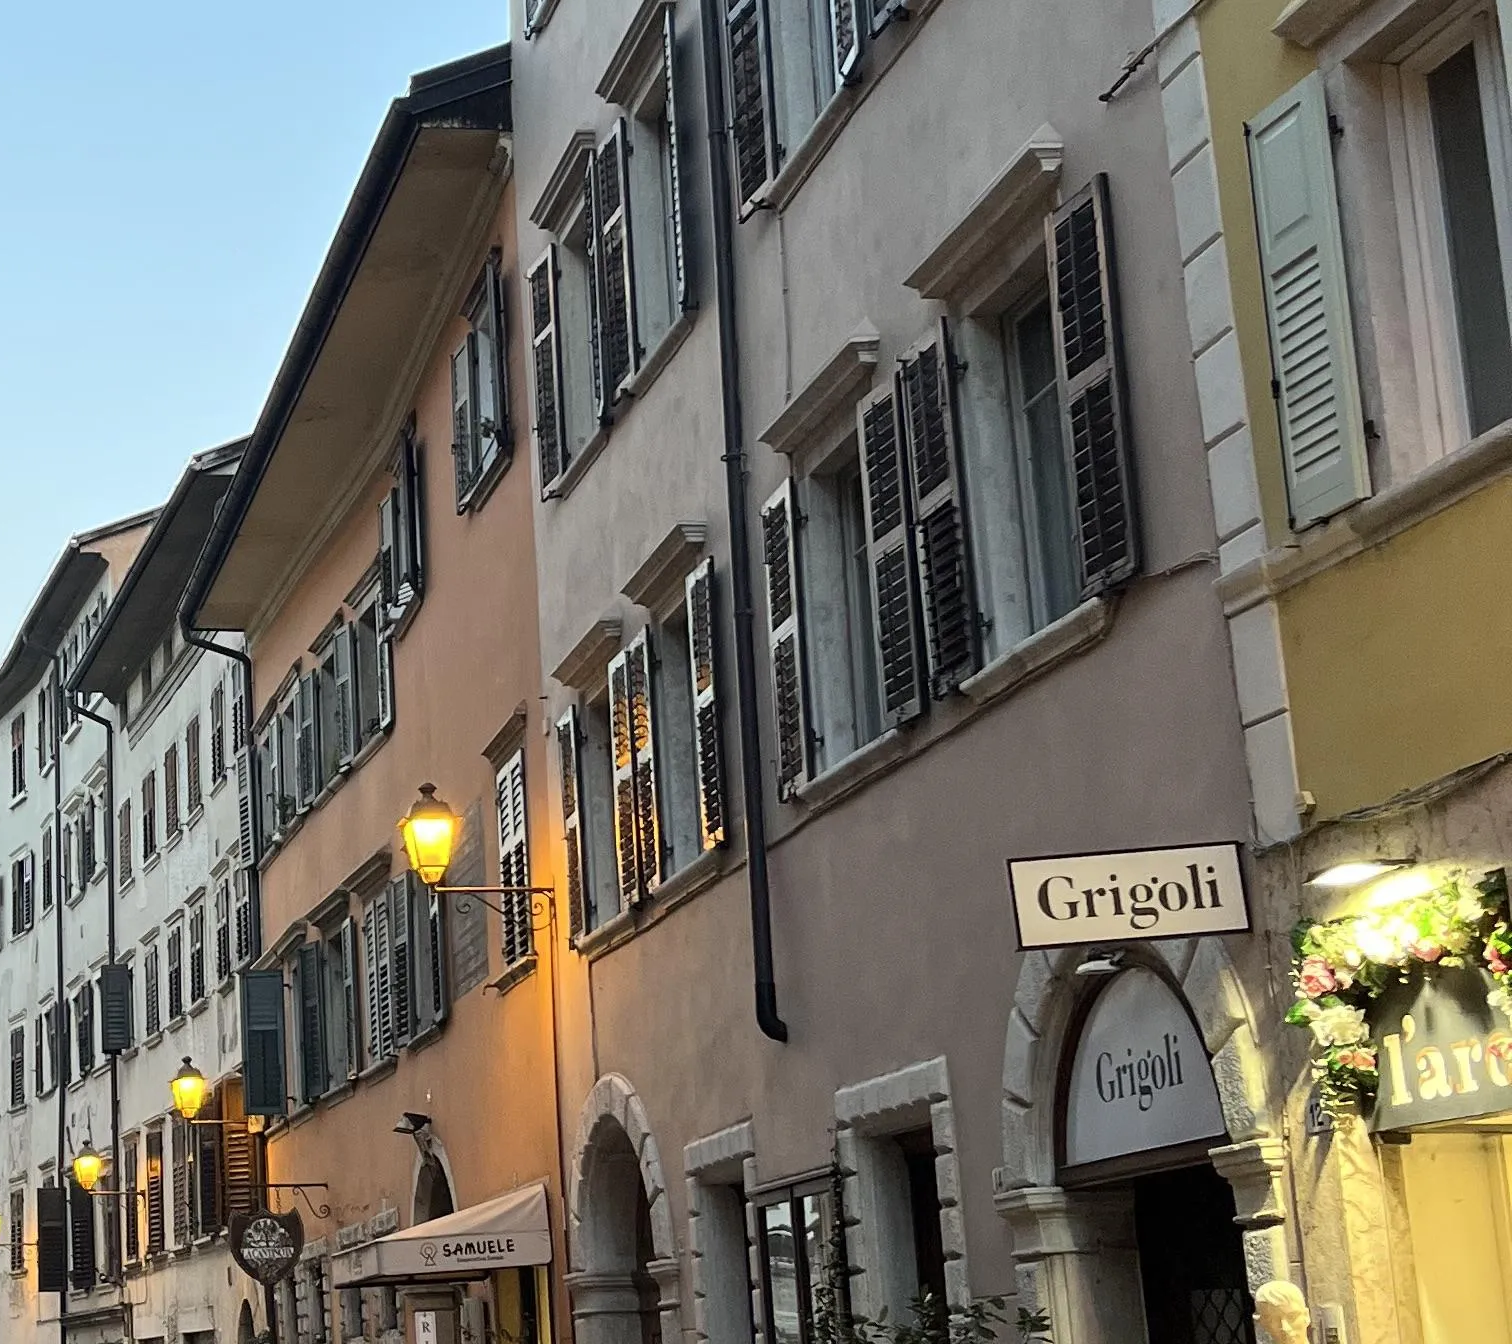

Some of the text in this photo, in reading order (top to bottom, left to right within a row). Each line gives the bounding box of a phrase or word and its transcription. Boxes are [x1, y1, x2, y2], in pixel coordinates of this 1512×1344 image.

[1037, 863, 1224, 930] Grigoli
[1095, 1032, 1184, 1112] Grigoli
[442, 1238, 516, 1258] SAMUELE
